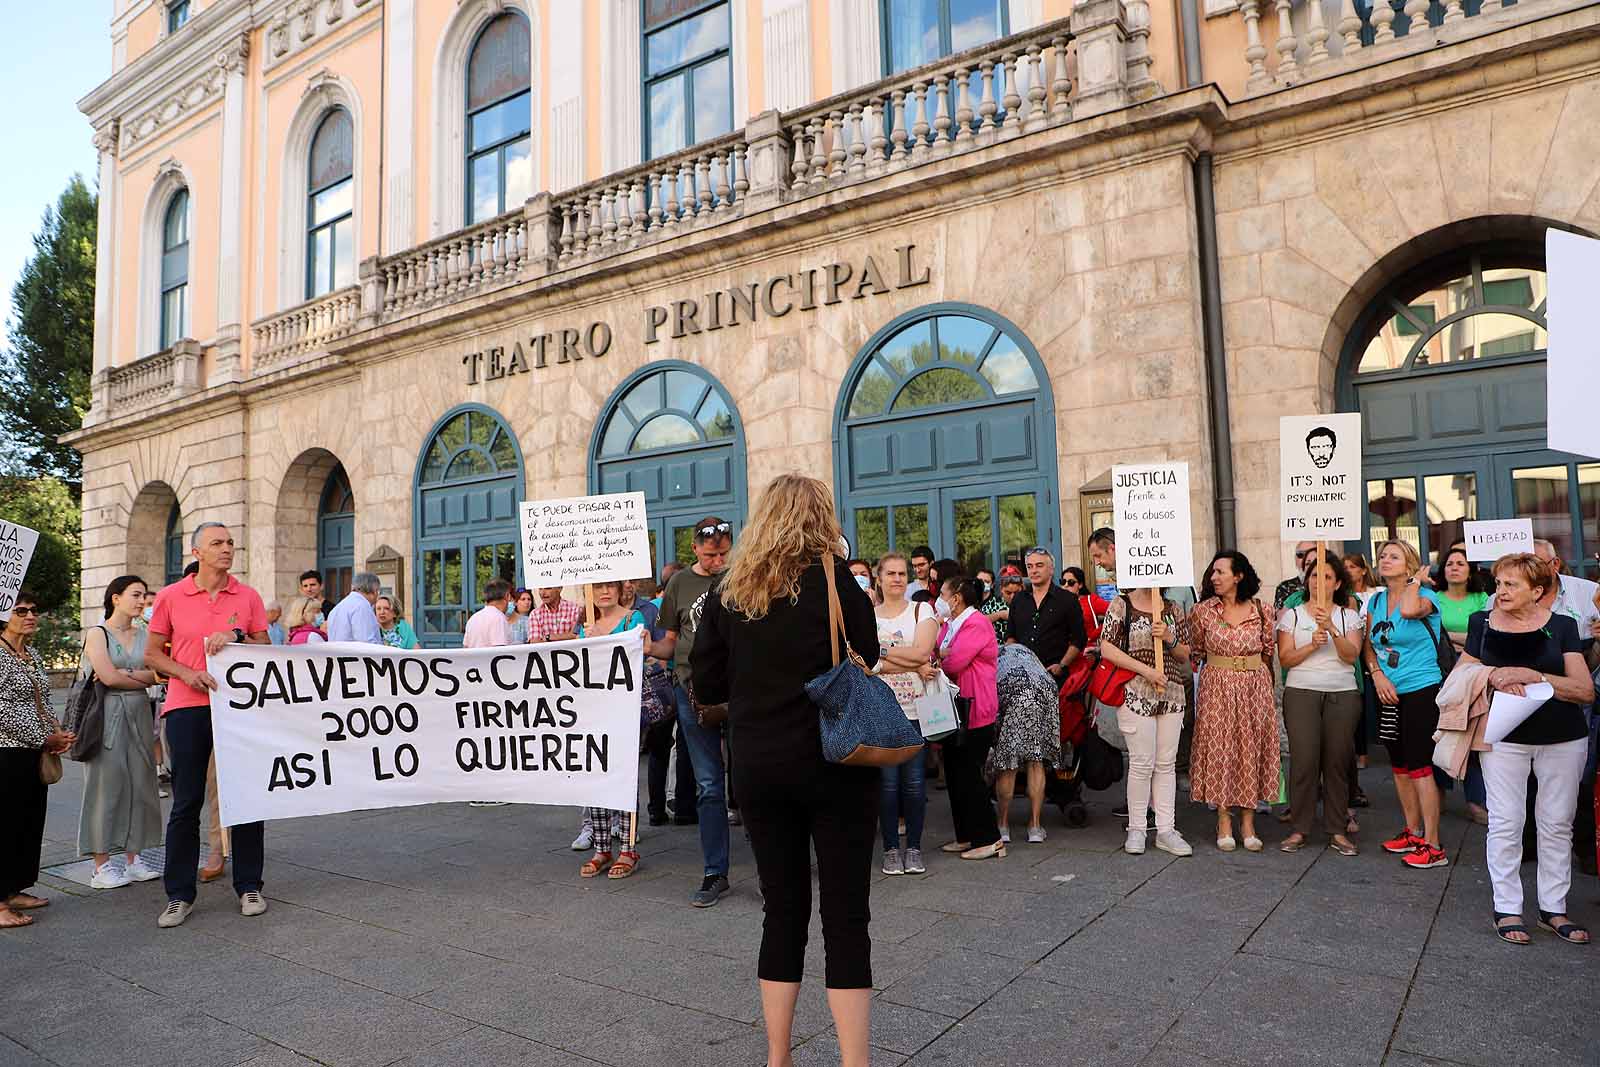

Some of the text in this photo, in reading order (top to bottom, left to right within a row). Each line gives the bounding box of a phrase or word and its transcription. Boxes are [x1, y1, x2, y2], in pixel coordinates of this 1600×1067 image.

[462, 243, 931, 386] TEATRO PRINCIPAL
[1116, 470, 1177, 488] JUSTICIA
[1290, 474, 1347, 487] IT'S NOT
[1128, 489, 1167, 505] frente a
[1287, 492, 1347, 503] PSYCHIATRIC
[527, 499, 634, 518] TE PUEDE PASAR A TI
[1124, 508, 1176, 520] los abusos
[527, 519, 537, 529] el
[1287, 517, 1345, 528] IT'S LYME
[529, 529, 538, 541] la
[568, 527, 579, 538] de
[1132, 528, 1160, 539] de la
[1473, 531, 1527, 544] LIBERTAD
[528, 545, 534, 557] y
[539, 542, 548, 552] el
[583, 538, 594, 547] de
[1128, 545, 1167, 557] CLASE
[541, 569, 552, 577] en
[1129, 561, 1174, 576] MÉDICA
[226, 645, 634, 709] SALVEMOS a CARLA
[321, 695, 577, 741] 2000 FIRMAS
[267, 733, 609, 792] ASI LO QUIEREN
